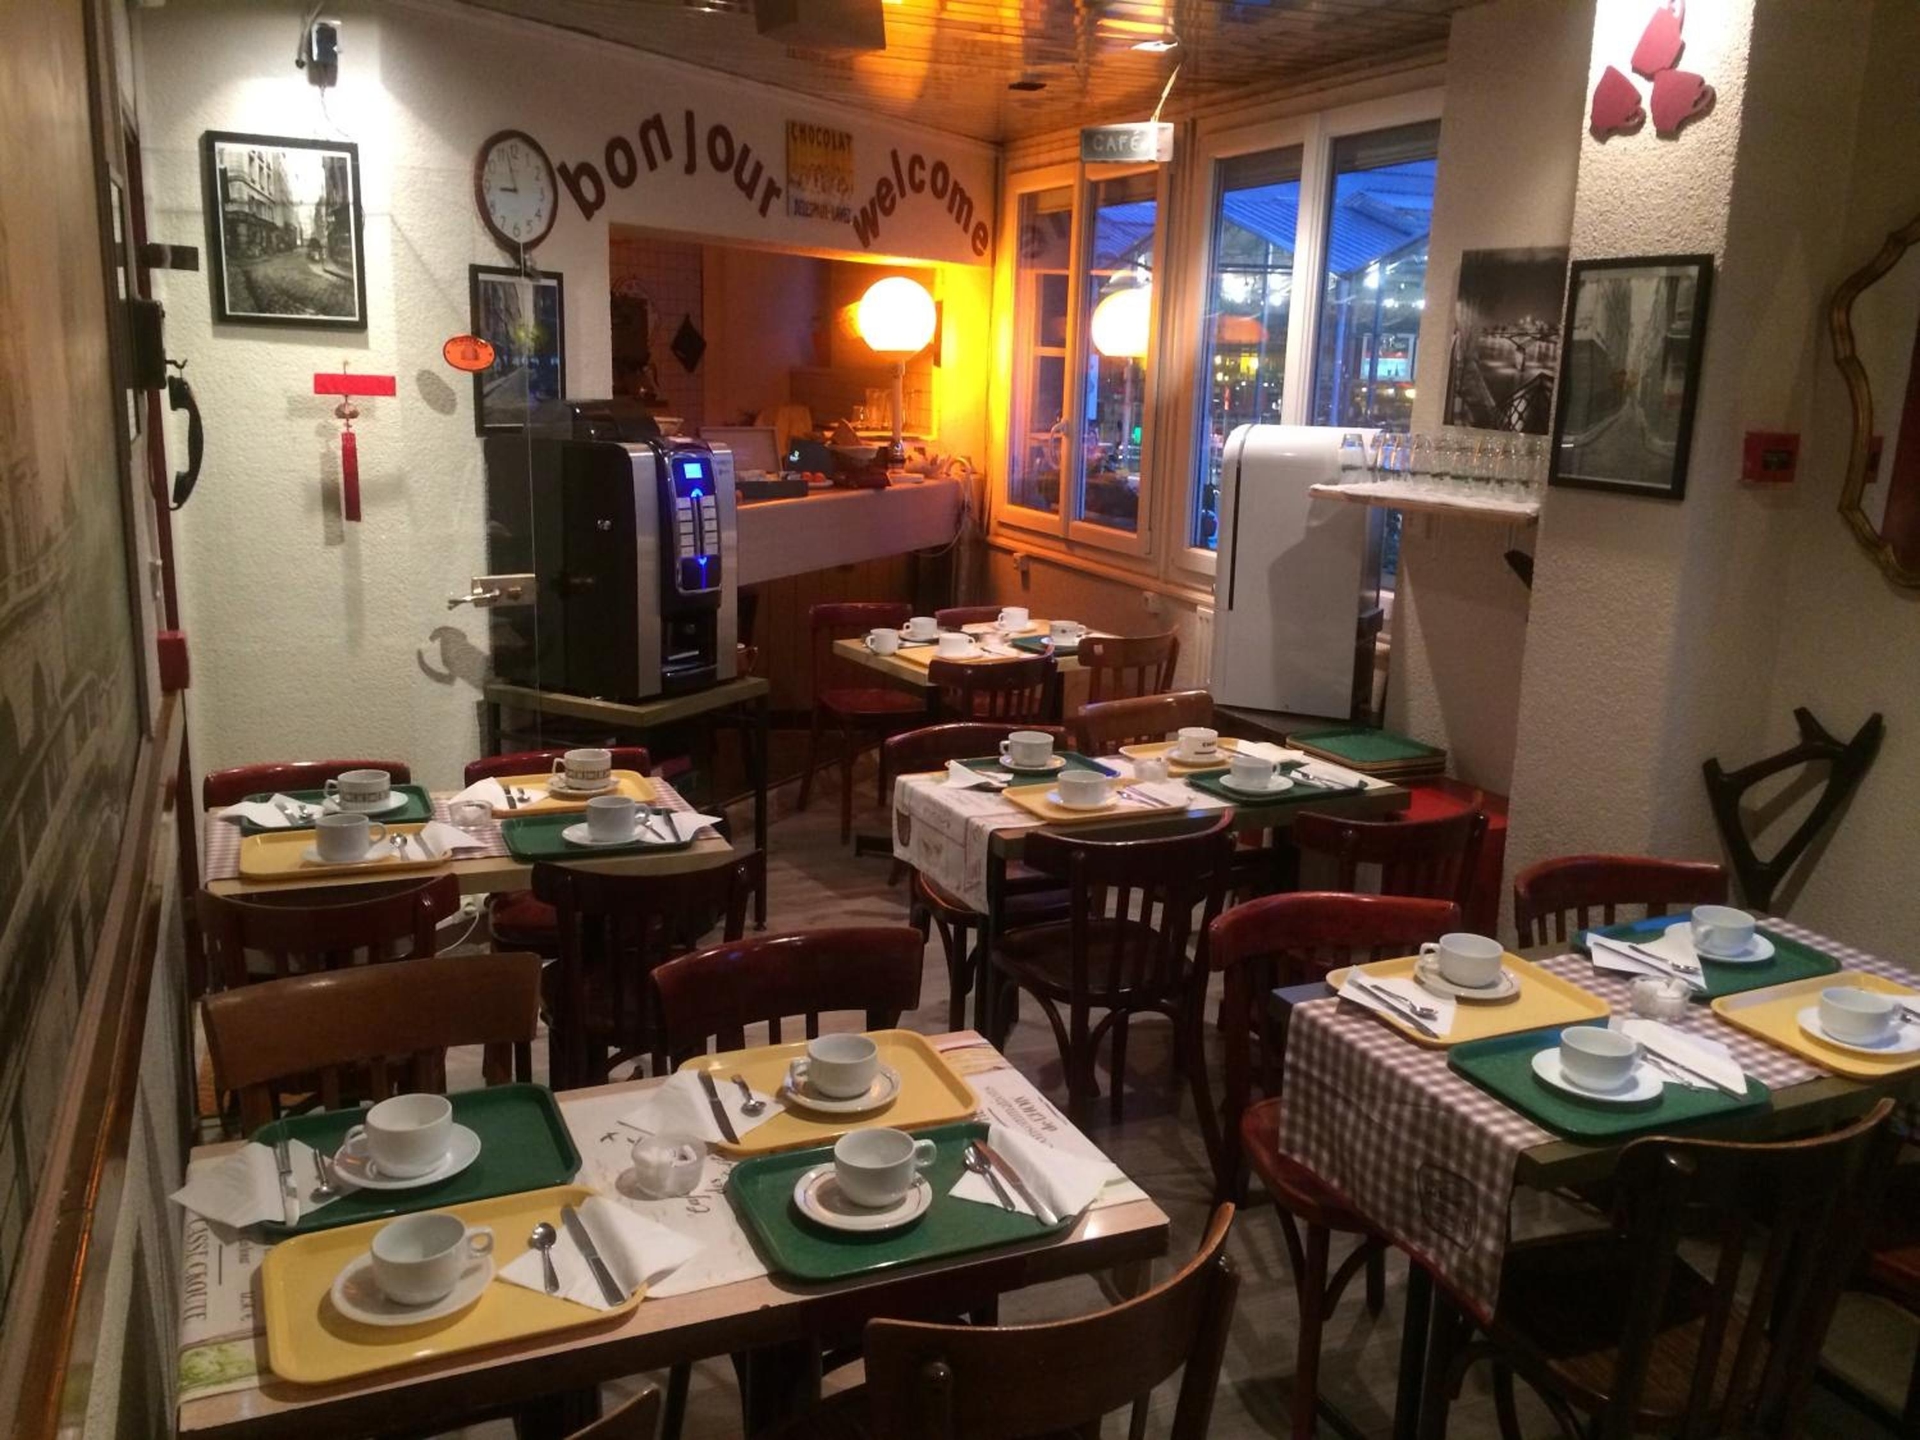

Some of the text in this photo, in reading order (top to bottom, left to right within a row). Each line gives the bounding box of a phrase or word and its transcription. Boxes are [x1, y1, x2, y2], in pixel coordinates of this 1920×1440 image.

[791, 122, 853, 153] CHOCOLAT
[1093, 131, 1141, 152] CAFÉ
[510, 143, 519, 160] 12
[557, 110, 783, 221] bonjour
[852, 149, 989, 257] welcome
[534, 207, 543, 222] 4
[512, 223, 521, 238] 6
[525, 219, 533, 234] 5
[183, 1261, 208, 1321] CROUTE
